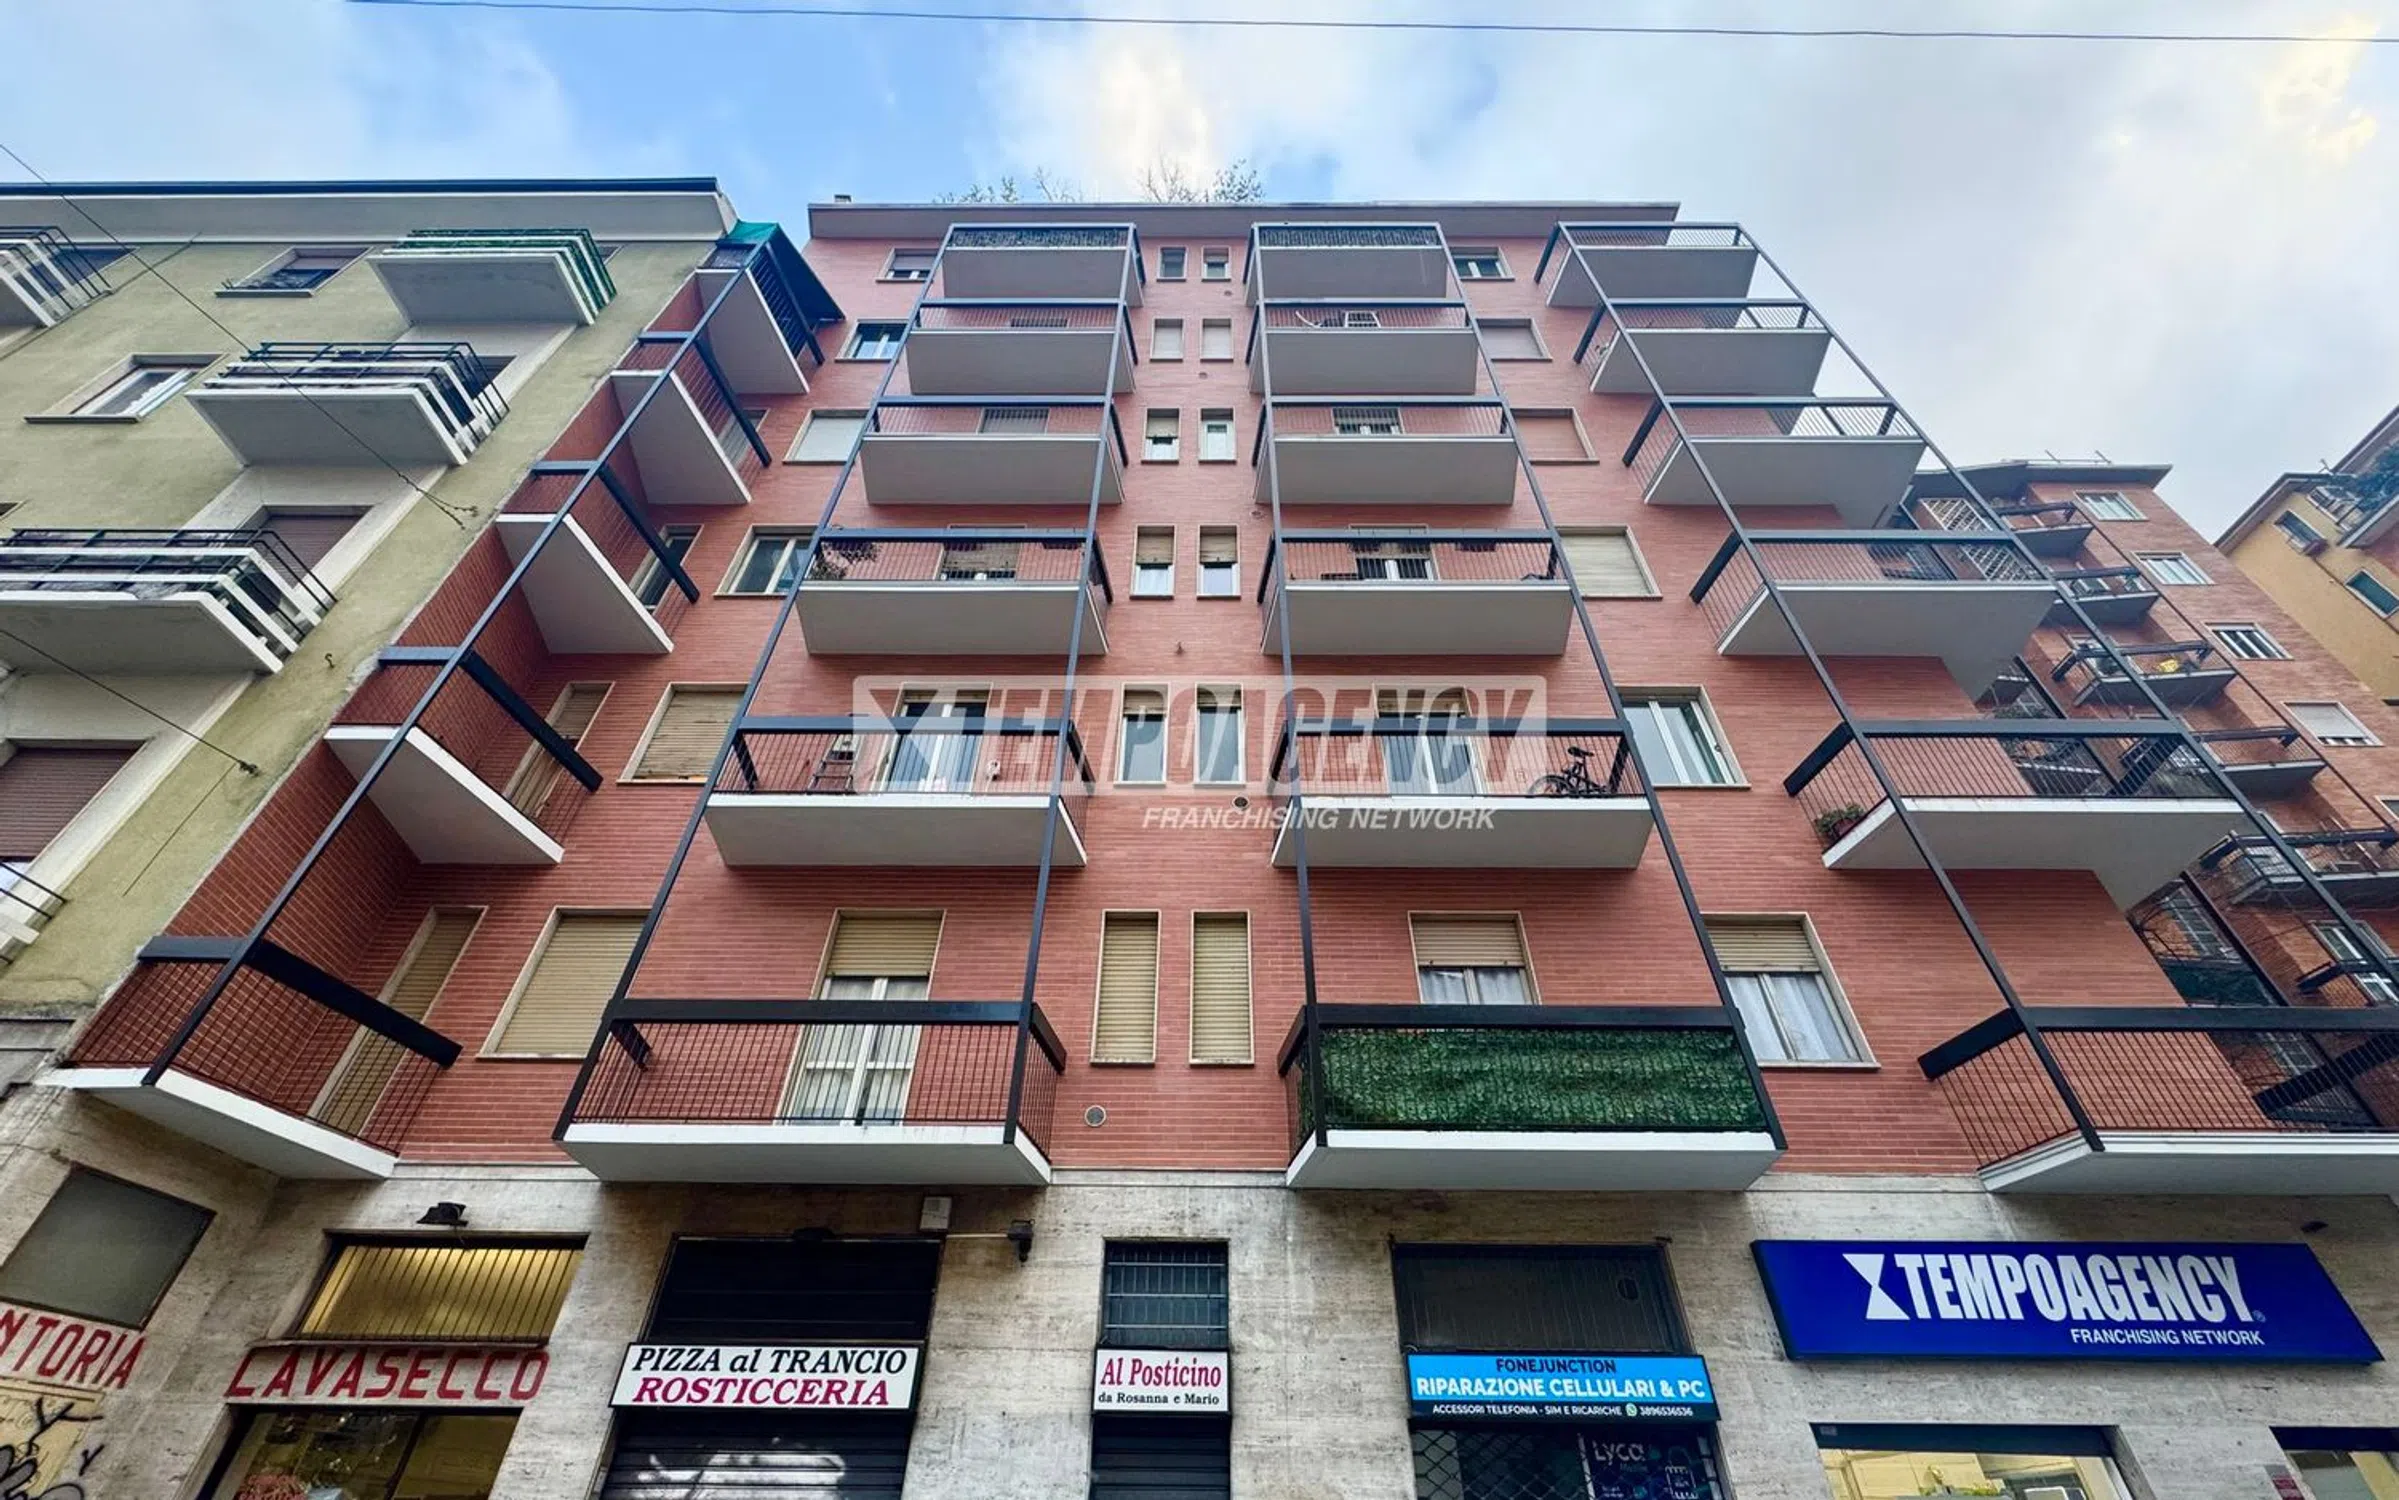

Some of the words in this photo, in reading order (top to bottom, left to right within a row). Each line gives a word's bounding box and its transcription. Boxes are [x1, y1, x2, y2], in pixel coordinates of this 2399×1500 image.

[1893, 1253, 2254, 1322] TEMPOAGENCY
[2070, 1328, 2180, 1345] FRANCHISING
[2181, 1330, 2266, 1346] NETWORK
[632, 1348, 721, 1372] PIZZA
[729, 1349, 762, 1373] al
[769, 1349, 907, 1374] TRANCIO
[1100, 1357, 1124, 1385] Al
[1128, 1357, 1222, 1388] Posticino
[1496, 1358, 1616, 1374] FONEJUNCTION
[223, 1347, 549, 1400] LAVASECCO
[632, 1376, 889, 1406] ROSTICCERIA
[1098, 1392, 1113, 1403] da
[1116, 1392, 1169, 1404] Rosanna
[1173, 1395, 1181, 1404] e
[1184, 1393, 1220, 1405] Mario
[1416, 1377, 1546, 1397] RIPARAZIONE
[1549, 1379, 1656, 1398] CELLULARI
[1660, 1380, 1676, 1398] &
[1678, 1380, 1706, 1398] PC
[1432, 1404, 1485, 1415] ACCESSORI
[1486, 1404, 1538, 1415] TELEFONIA
[1544, 1405, 1561, 1415] SIM
[1564, 1405, 1570, 1415] E
[1572, 1405, 1622, 1416] RICARICHE
